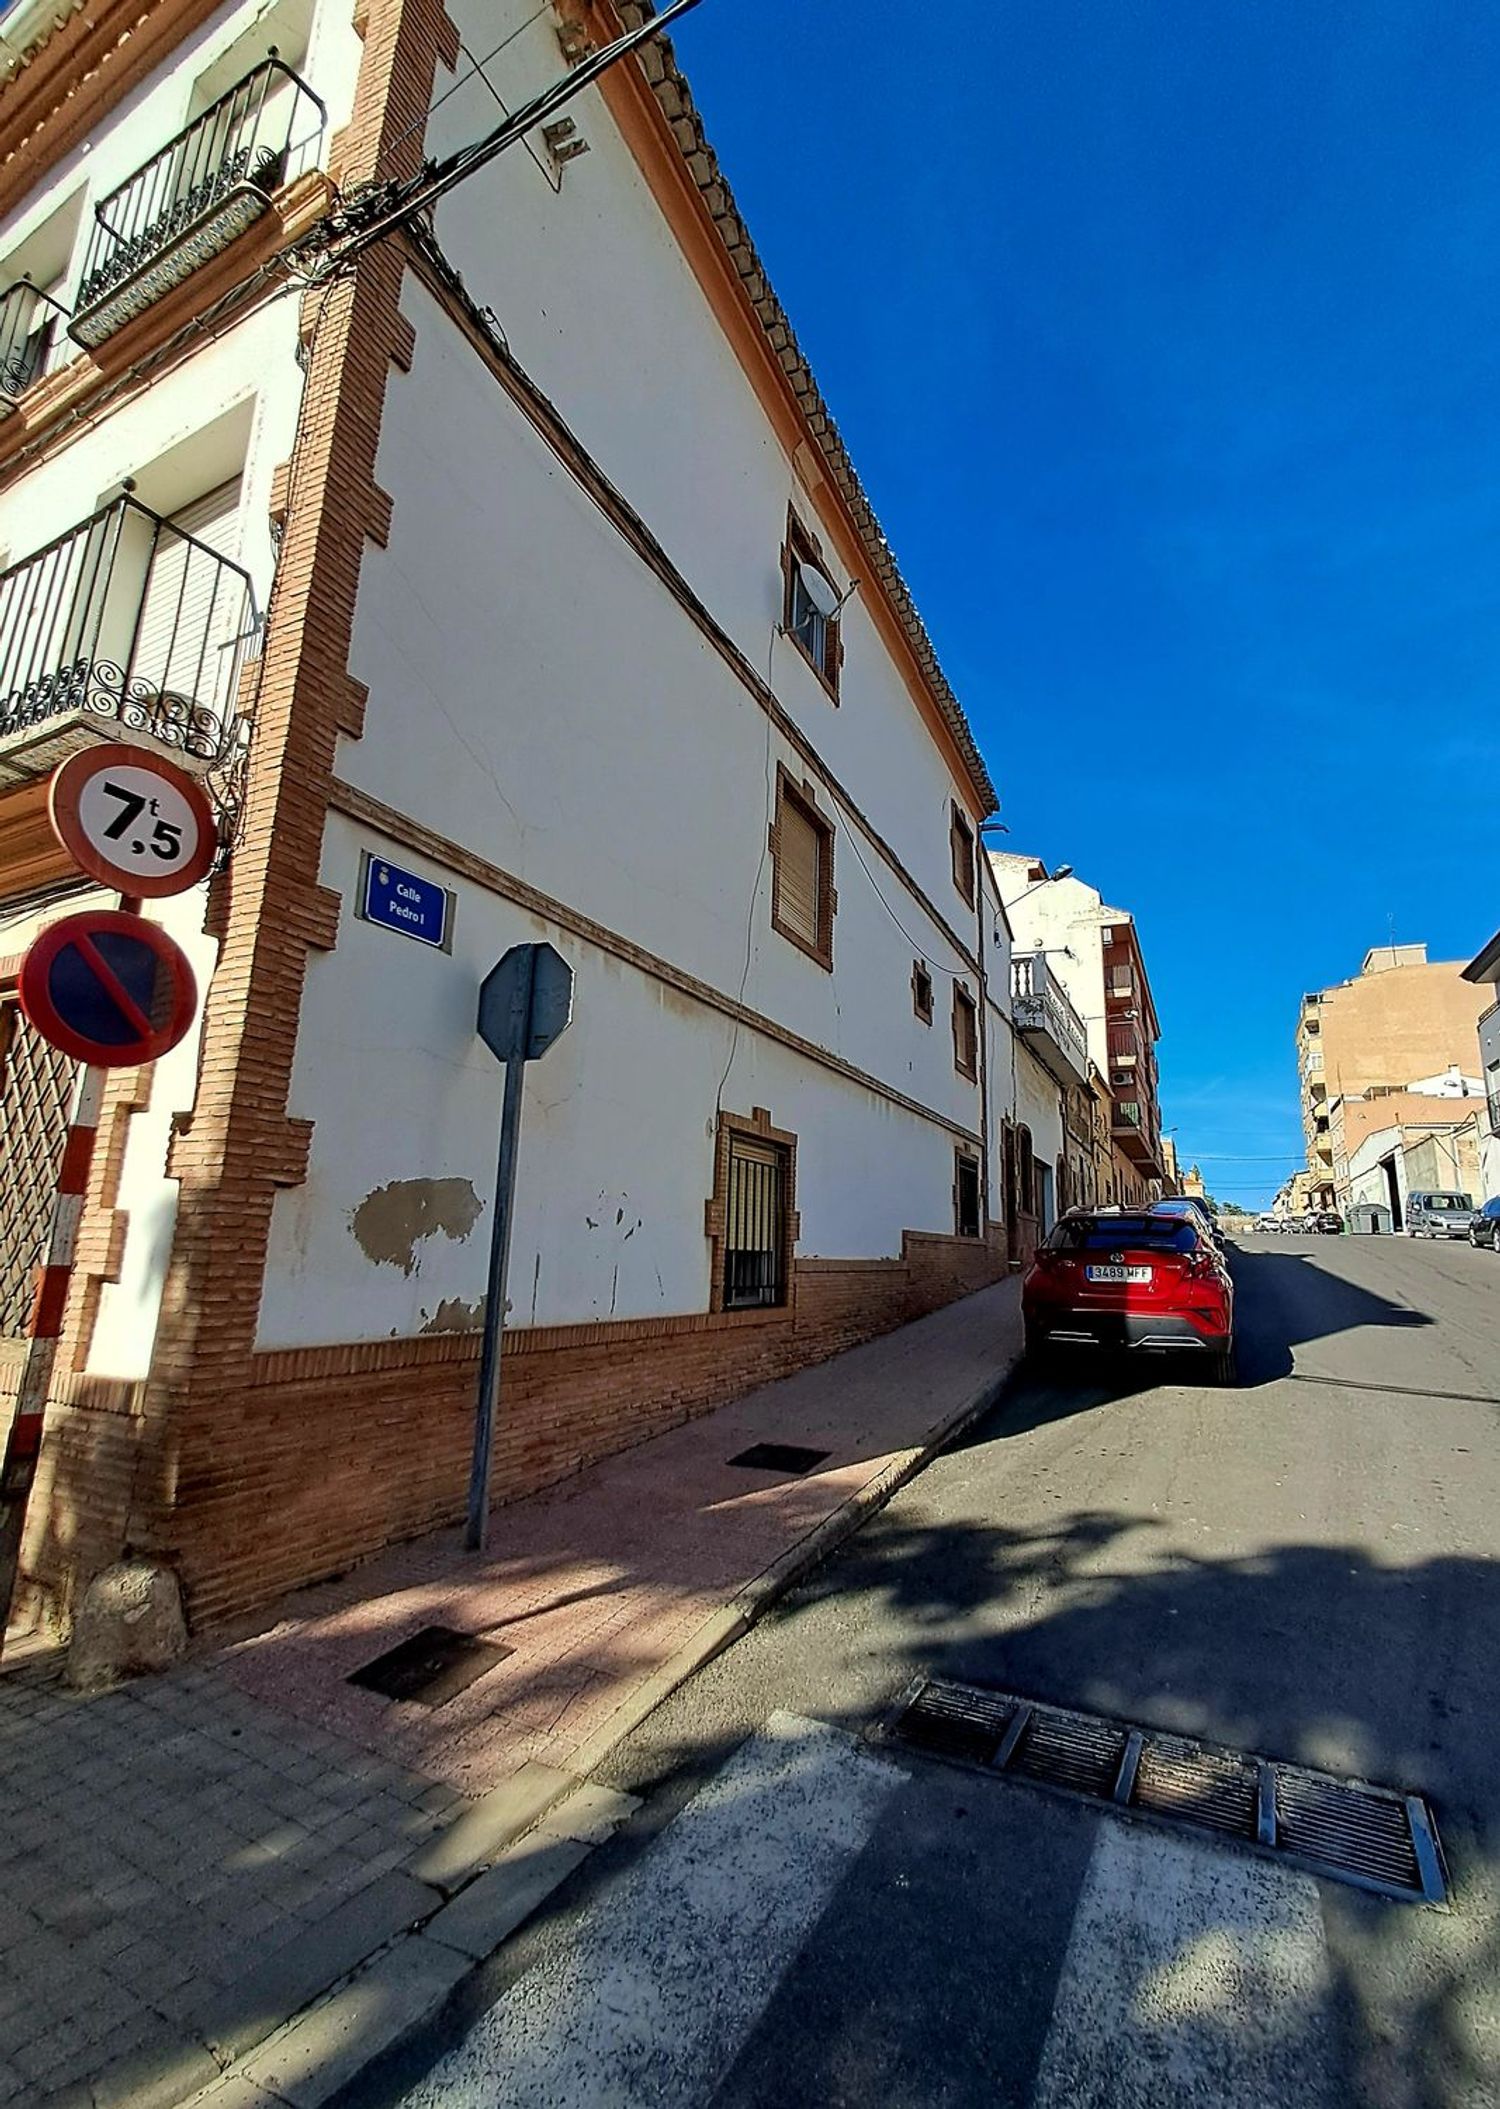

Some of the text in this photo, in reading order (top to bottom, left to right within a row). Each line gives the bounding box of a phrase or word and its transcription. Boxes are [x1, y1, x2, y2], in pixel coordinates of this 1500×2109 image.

[396, 884, 421, 903] Calle
[389, 900, 425, 925] Pedro I
[1095, 1266, 1123, 1278] 3489
